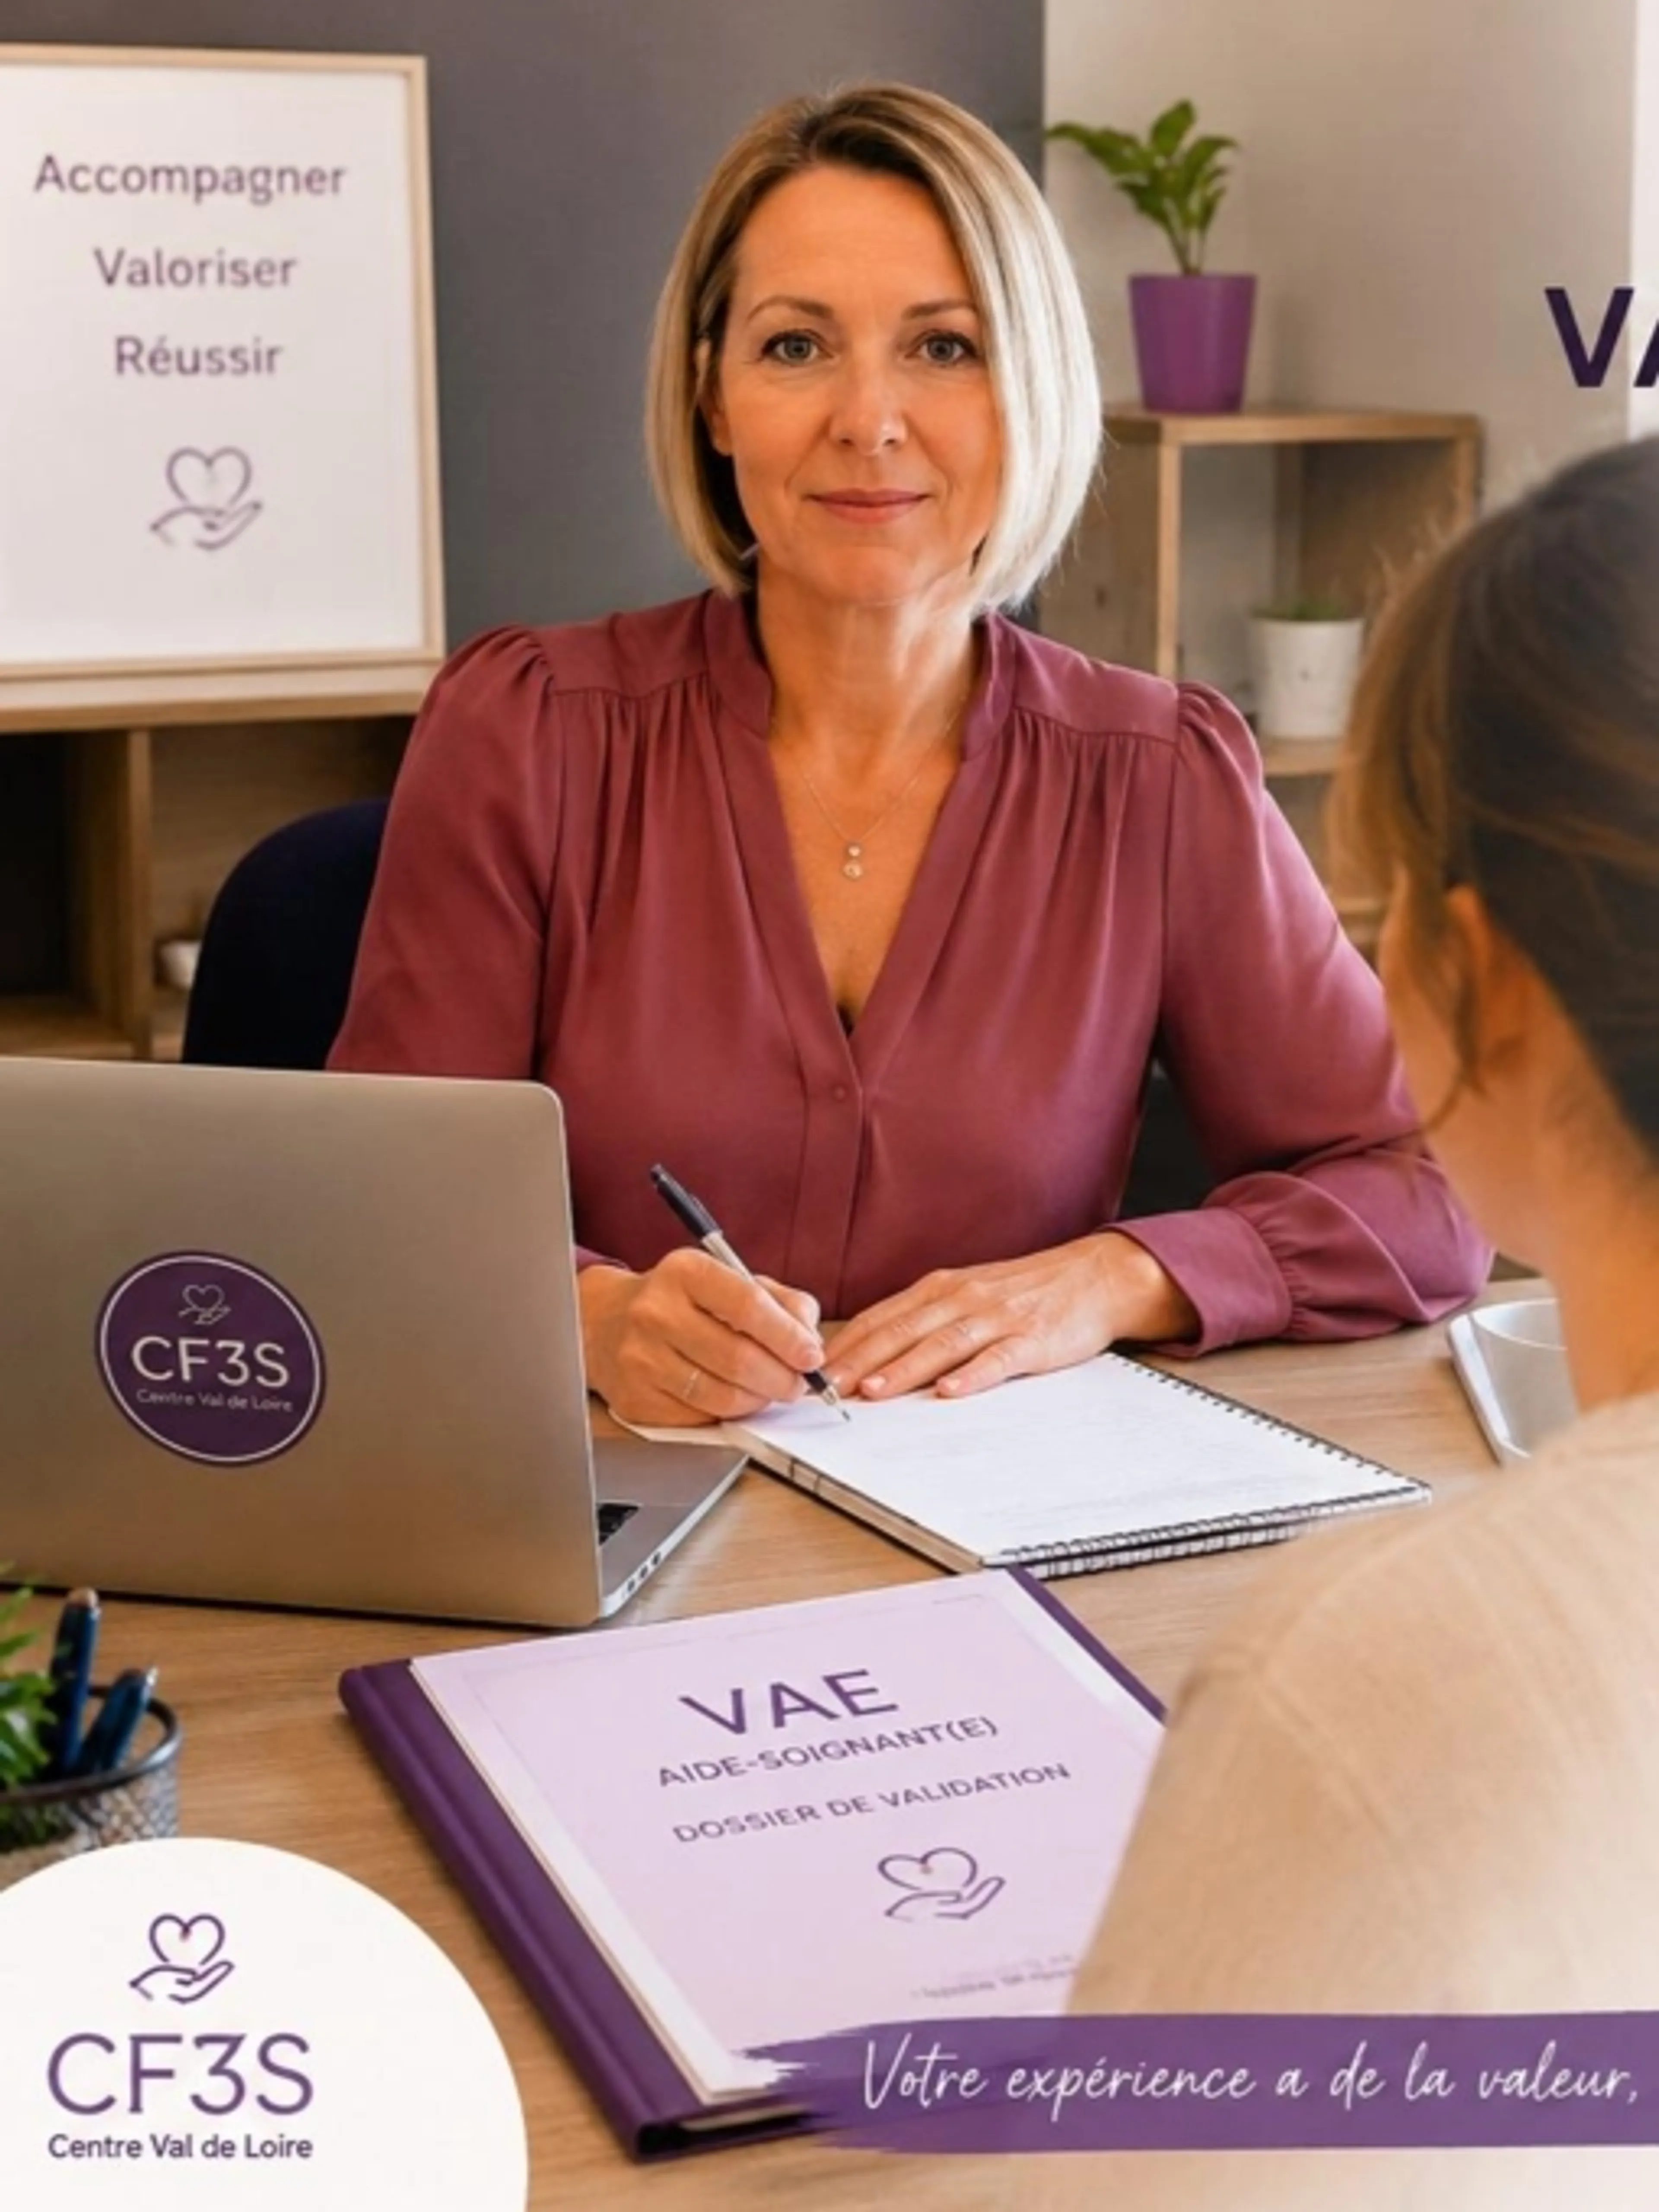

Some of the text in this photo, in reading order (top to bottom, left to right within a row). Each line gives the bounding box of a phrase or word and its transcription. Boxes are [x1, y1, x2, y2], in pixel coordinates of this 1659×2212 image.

[34, 154, 347, 207] Accompagner
[93, 247, 298, 288] Valoriser
[115, 334, 283, 375] Réussir
[132, 1336, 289, 1388] CF3S
[136, 1388, 294, 1413] Centre Val de Loire
[679, 1669, 899, 1735] VAE
[658, 1715, 999, 1787] AIDE-SOIGNANT(E)
[672, 1762, 1071, 1843] DOSSIER DE VALIDATION
